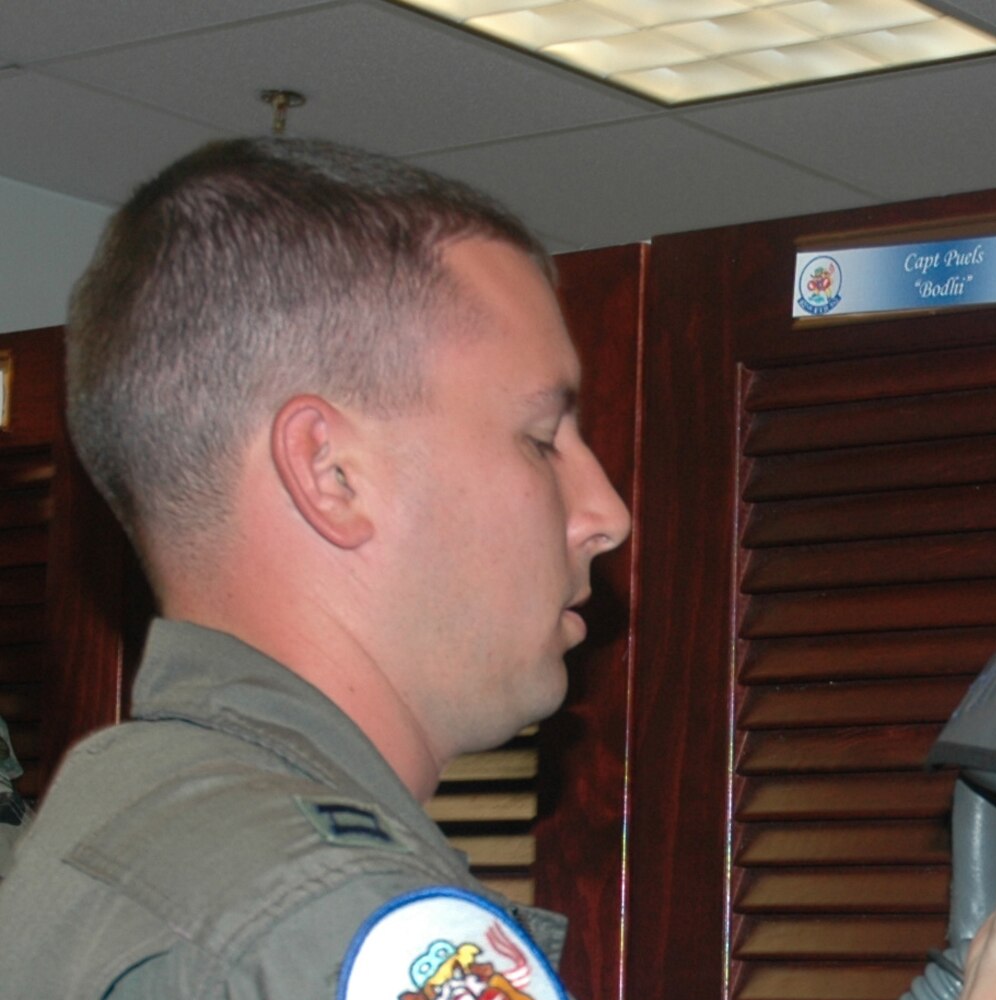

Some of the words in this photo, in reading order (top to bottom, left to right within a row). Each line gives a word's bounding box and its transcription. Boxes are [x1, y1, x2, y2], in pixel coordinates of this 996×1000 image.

[904, 251, 940, 274] Capt
[944, 244, 985, 267] Puels
[915, 274, 974, 298] "Bodhi"
